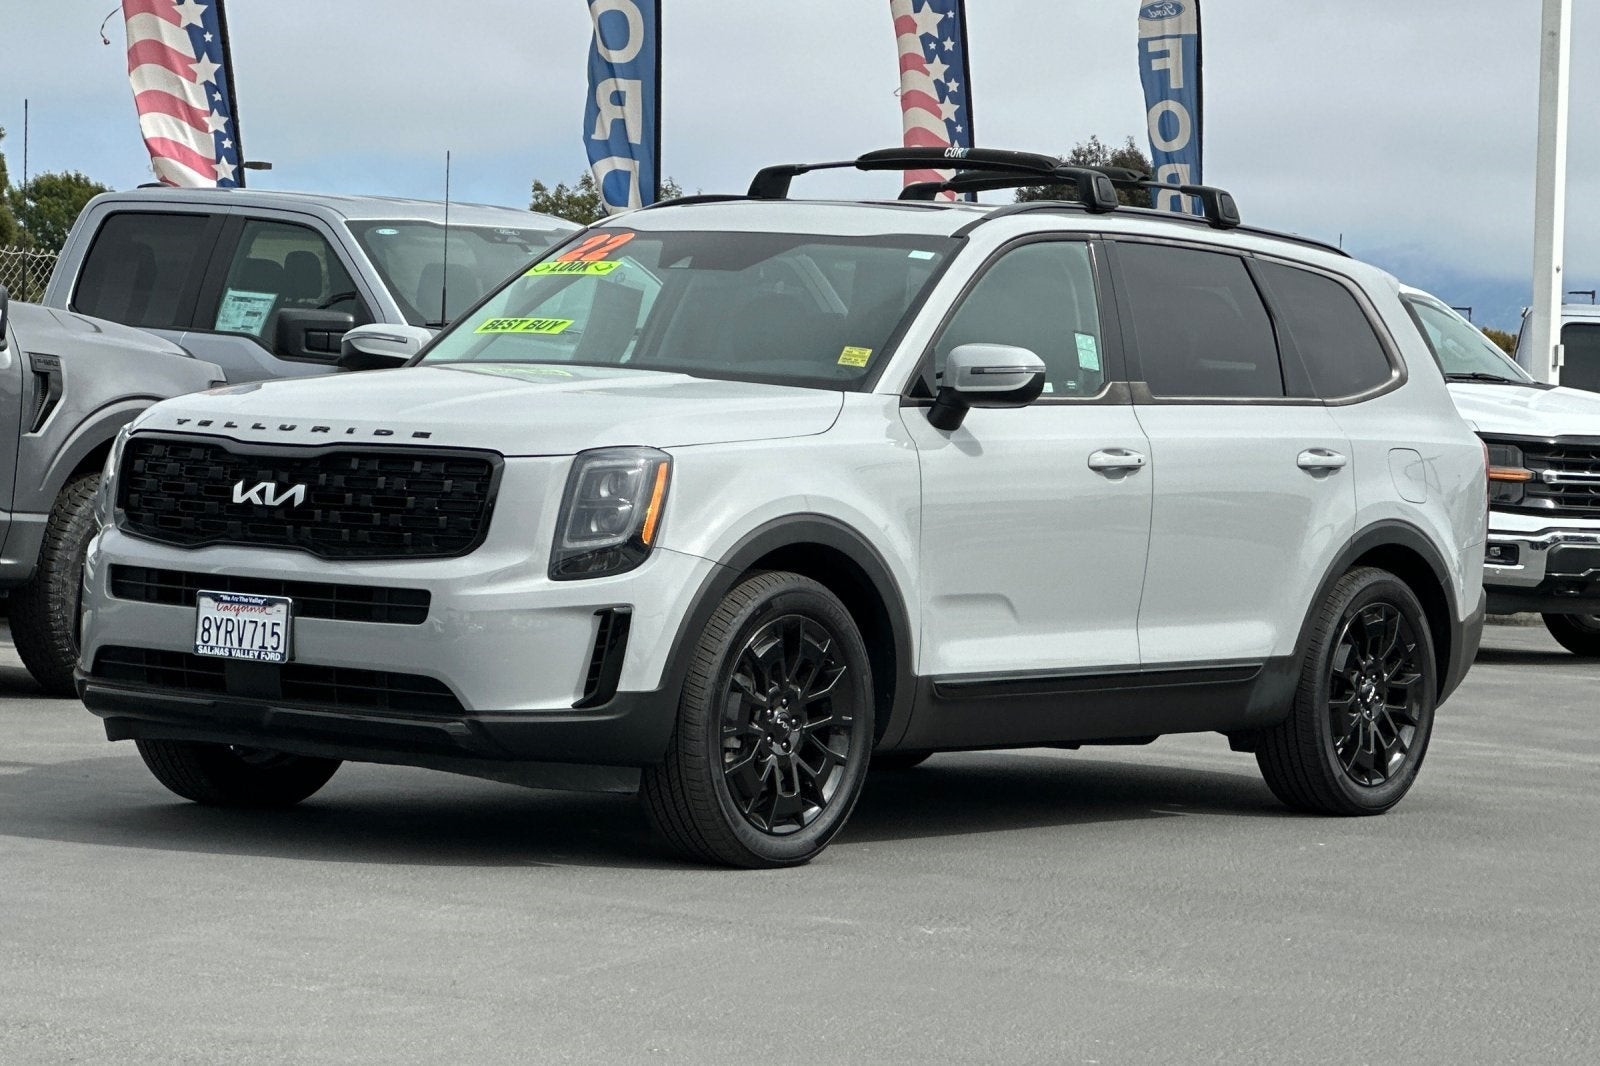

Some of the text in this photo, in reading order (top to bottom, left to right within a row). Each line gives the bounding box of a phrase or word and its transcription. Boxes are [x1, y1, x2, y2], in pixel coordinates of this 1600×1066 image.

[555, 232, 635, 262] 22
[549, 261, 593, 272] LOOK
[481, 319, 568, 331] BEST BUY
[177, 418, 432, 439] TELLURIDE
[216, 603, 272, 616] California
[201, 616, 281, 651] 8YRV715
[231, 648, 259, 659] VALLEY
[260, 651, 281, 661] FORD
